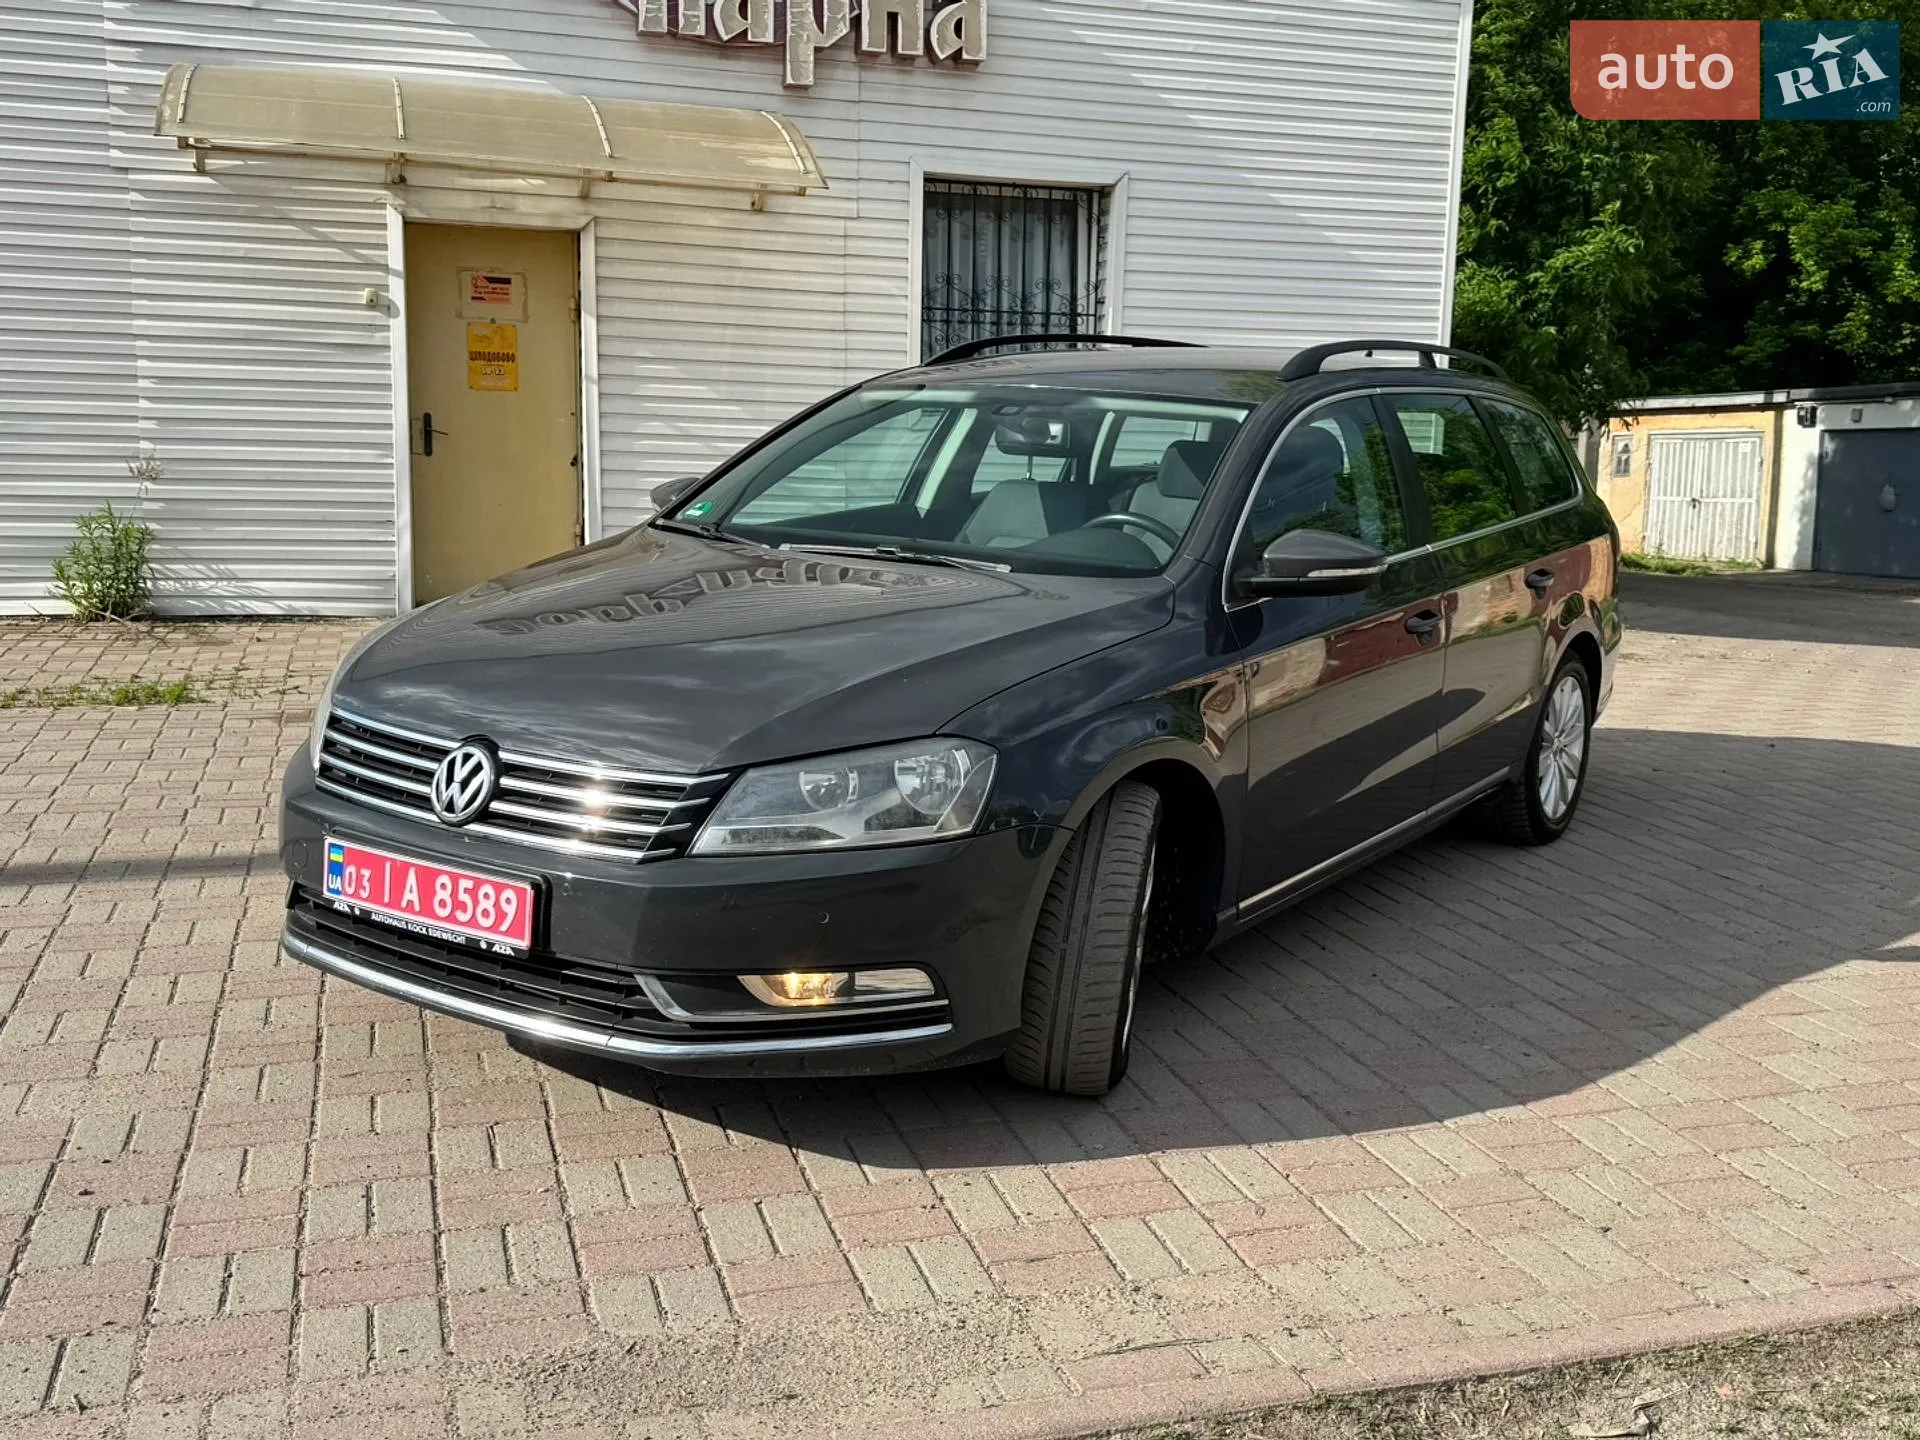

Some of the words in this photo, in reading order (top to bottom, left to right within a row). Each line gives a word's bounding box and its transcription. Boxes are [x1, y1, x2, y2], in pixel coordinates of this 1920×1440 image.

[327, 873, 342, 891] UA
[344, 866, 372, 899] 03
[433, 874, 518, 932] 8589
[371, 912, 407, 929] AUTOHAUS
